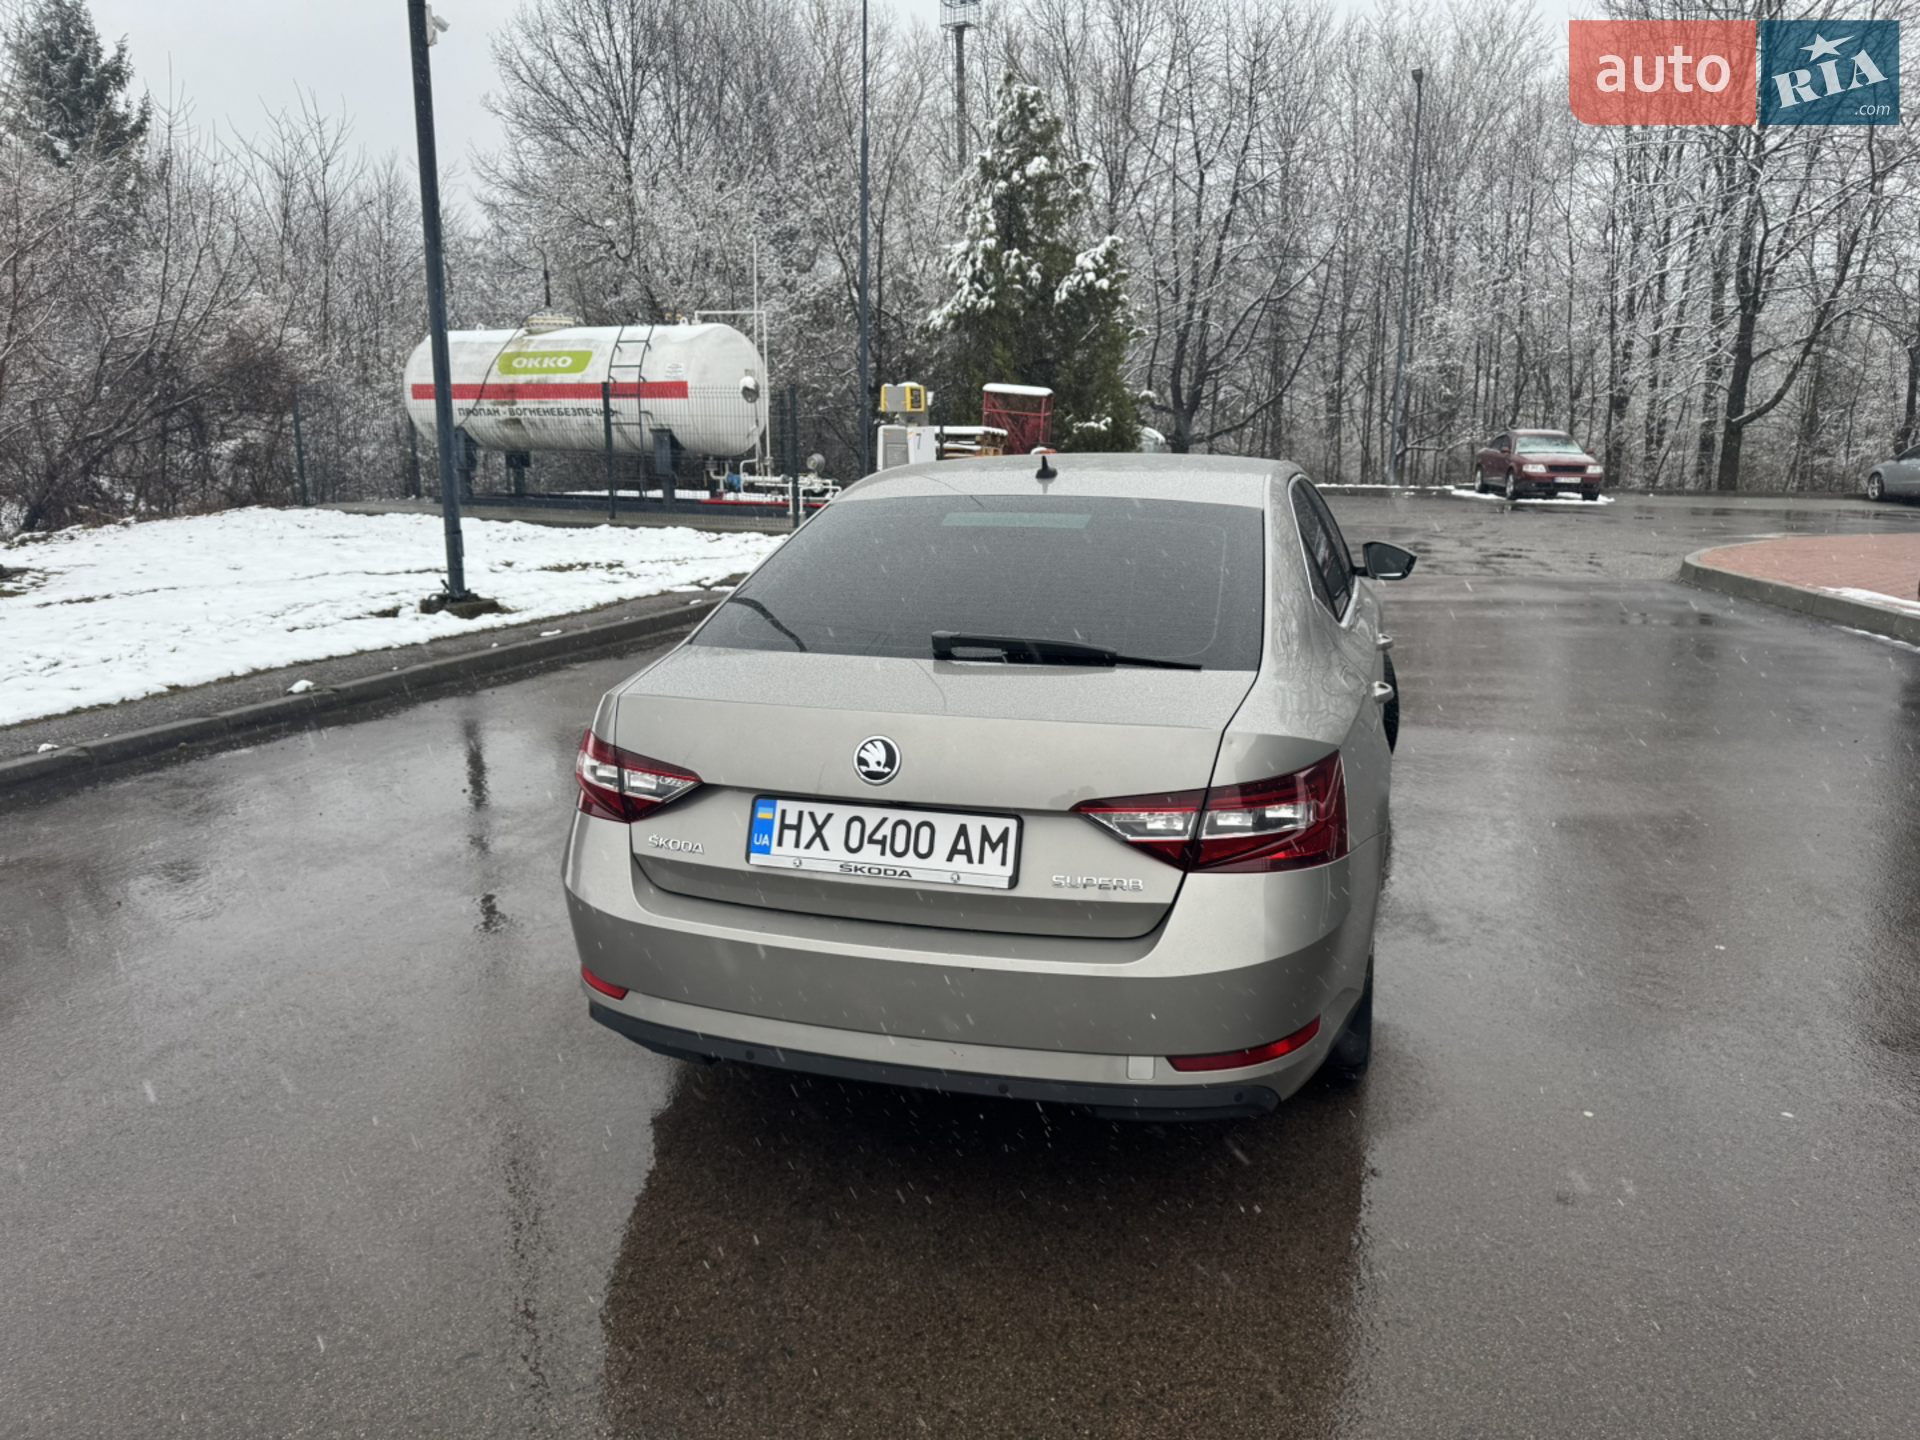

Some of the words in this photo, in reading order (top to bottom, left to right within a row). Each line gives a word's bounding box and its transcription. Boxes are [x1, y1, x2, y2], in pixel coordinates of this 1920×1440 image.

[512, 356, 573, 369] OKKO
[458, 407, 500, 416] ПРОПАН
[916, 433, 922, 450] 7
[648, 833, 705, 855] ŠKODA
[754, 833, 770, 846] UA
[776, 809, 834, 851] HX
[844, 815, 936, 860] 0400
[946, 823, 1010, 867] AM
[1051, 874, 1144, 892] SUPERB
